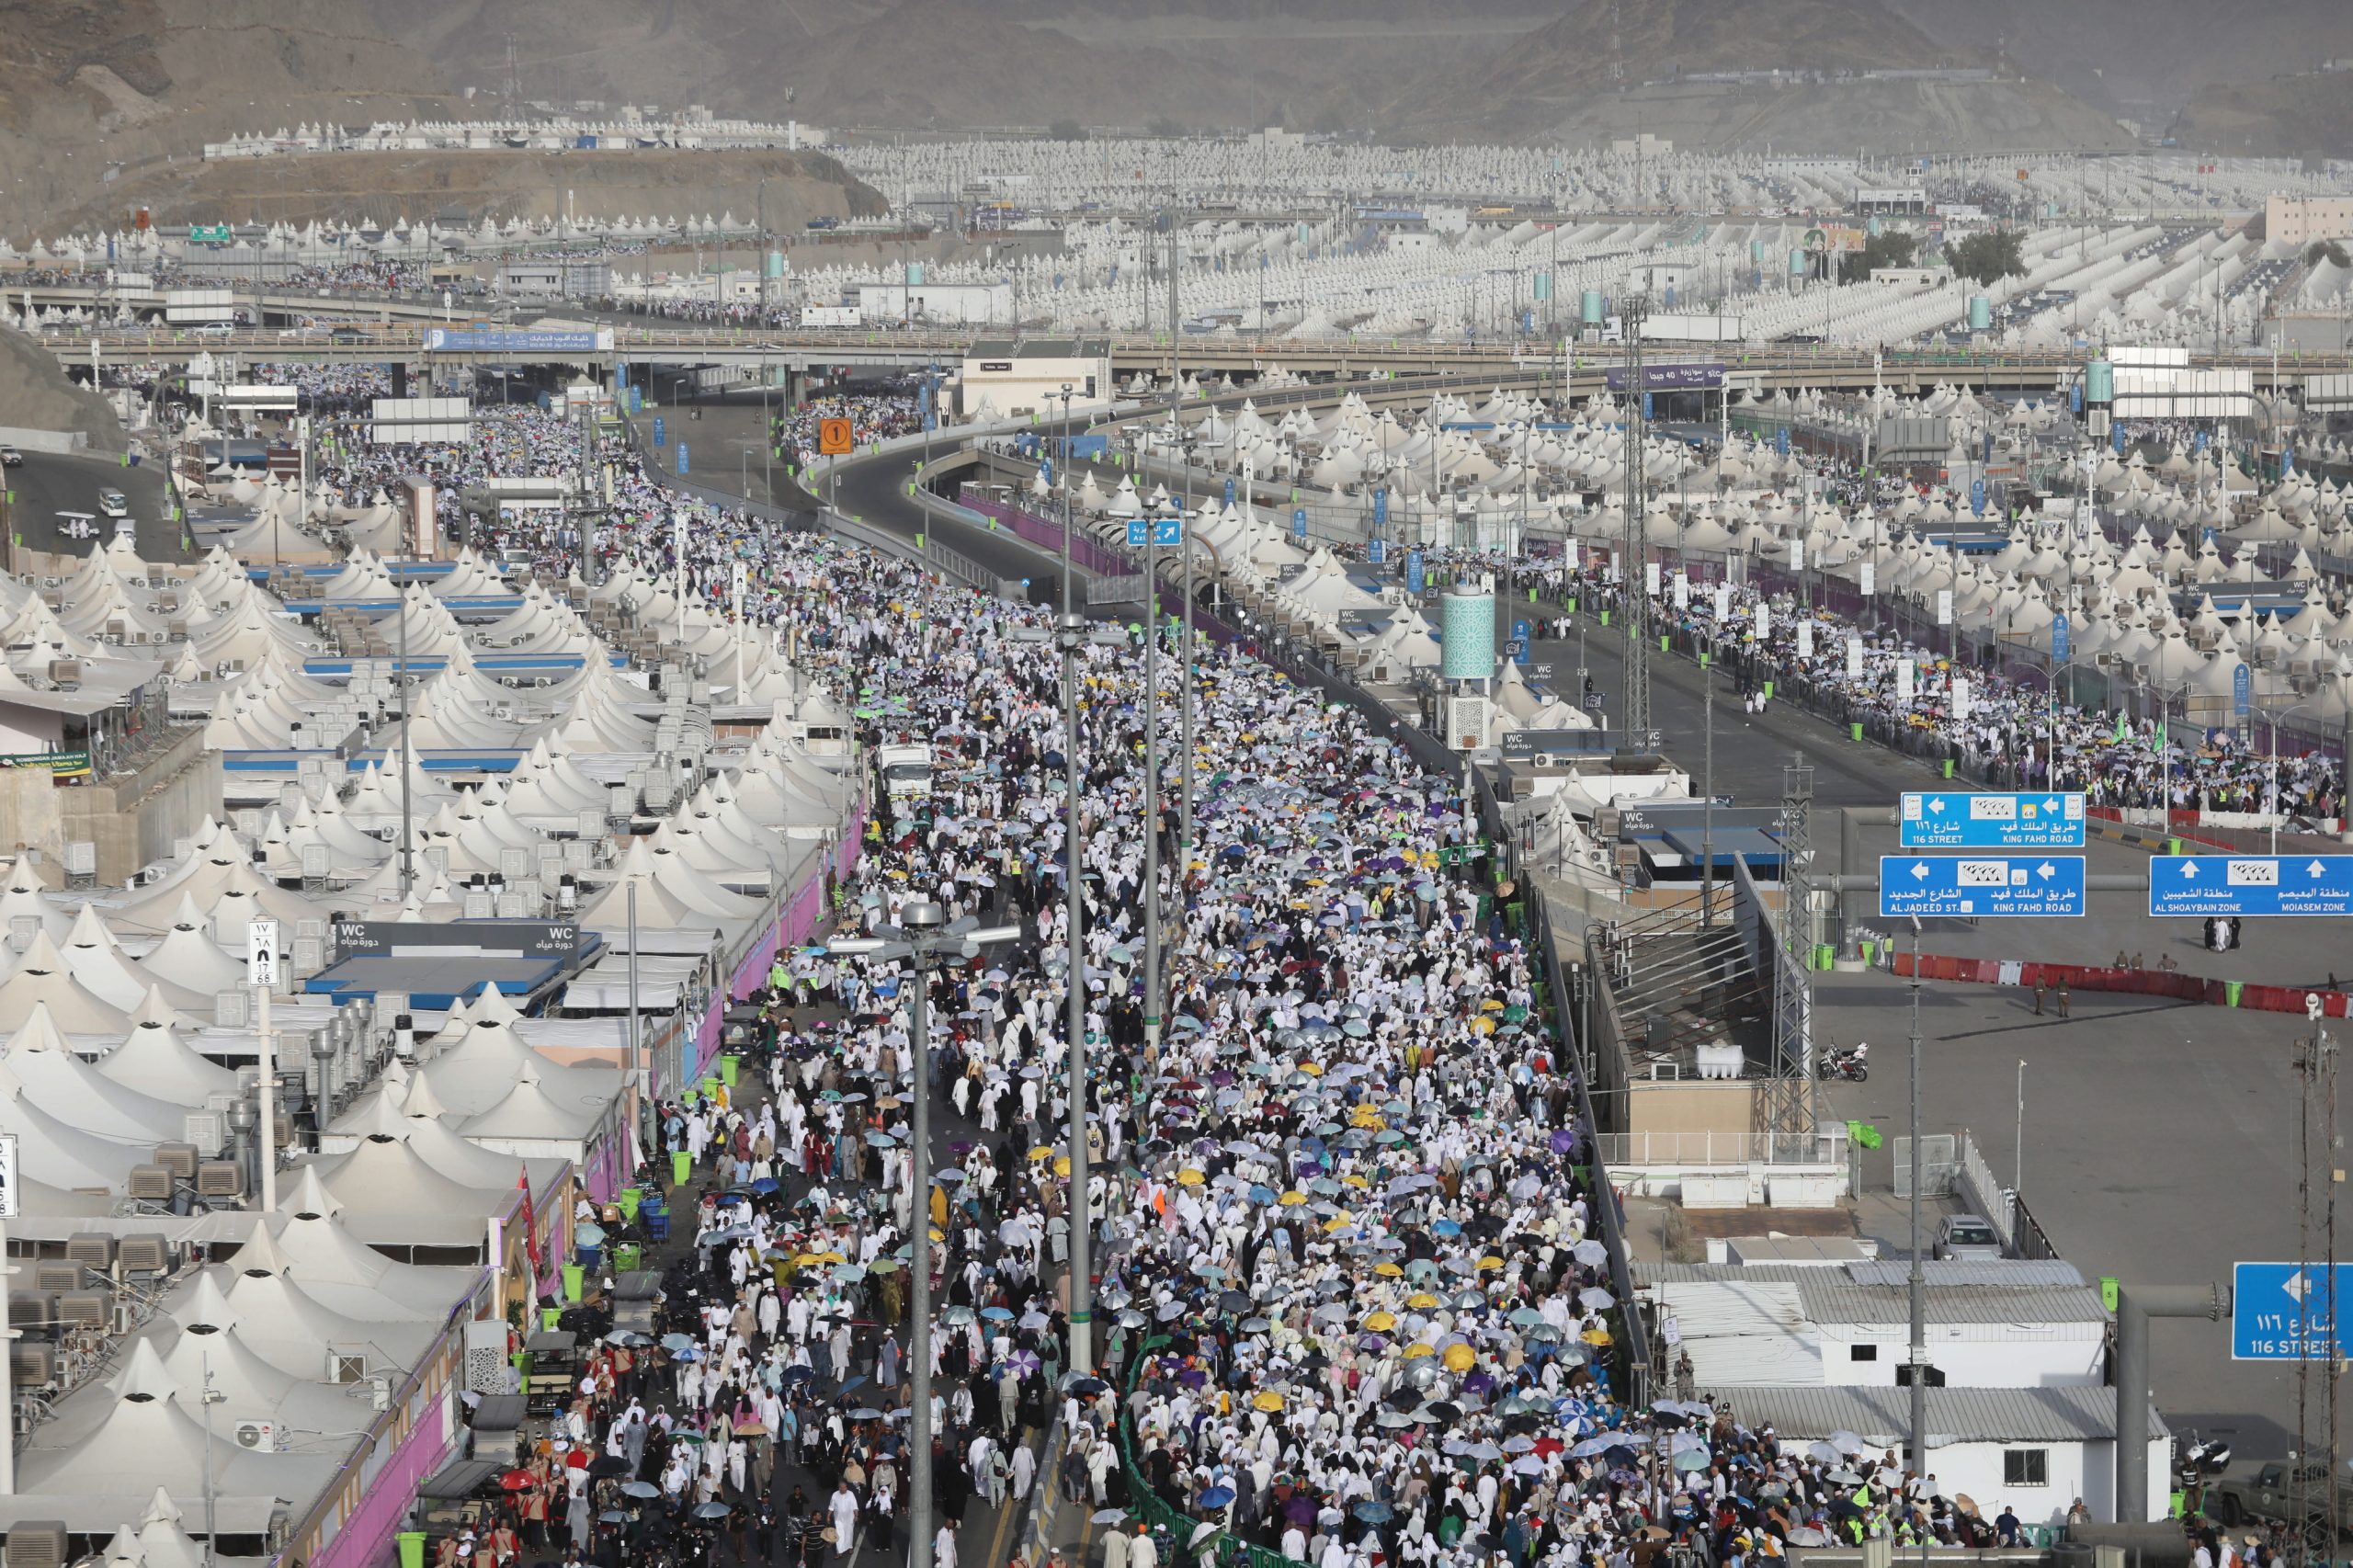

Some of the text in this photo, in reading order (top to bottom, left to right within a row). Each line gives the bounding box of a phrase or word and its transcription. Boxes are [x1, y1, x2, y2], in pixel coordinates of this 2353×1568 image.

[1666, 371, 1676, 380] 40
[1506, 734, 1522, 743] WC
[1506, 742, 1518, 750] مياه
[1625, 812, 1643, 822] WC
[1915, 821, 1960, 834] شارع ١١٦
[1999, 821, 2077, 834] طريق الملك فهد
[1913, 835, 1963, 844] 116 STREET
[1889, 888, 1961, 902] الشارع الجديد
[1990, 887, 2077, 901] طريق الملك فهد
[2163, 888, 2233, 900] منطقة الشعيبين
[2278, 888, 2350, 901] منطقة المعيصم
[1945, 903, 1960, 913] ST.
[1993, 903, 2072, 913] KING FAHD ROAD
[2154, 903, 2242, 913] AL SHOAYBAIN ZONE
[2281, 903, 2346, 912] MOIASEM ZONE
[256, 924, 268, 934] ١٧
[341, 924, 365, 937] WC
[549, 927, 574, 939] WC
[256, 937, 269, 948] ٦٨
[340, 937, 379, 948] دورة مياه
[536, 941, 574, 950] دورة مياه
[258, 963, 268, 972] 17
[257, 973, 270, 983] 68
[2256, 1313, 2282, 1331] ١١٦
[2251, 1340, 2342, 1354] 116 STREET
